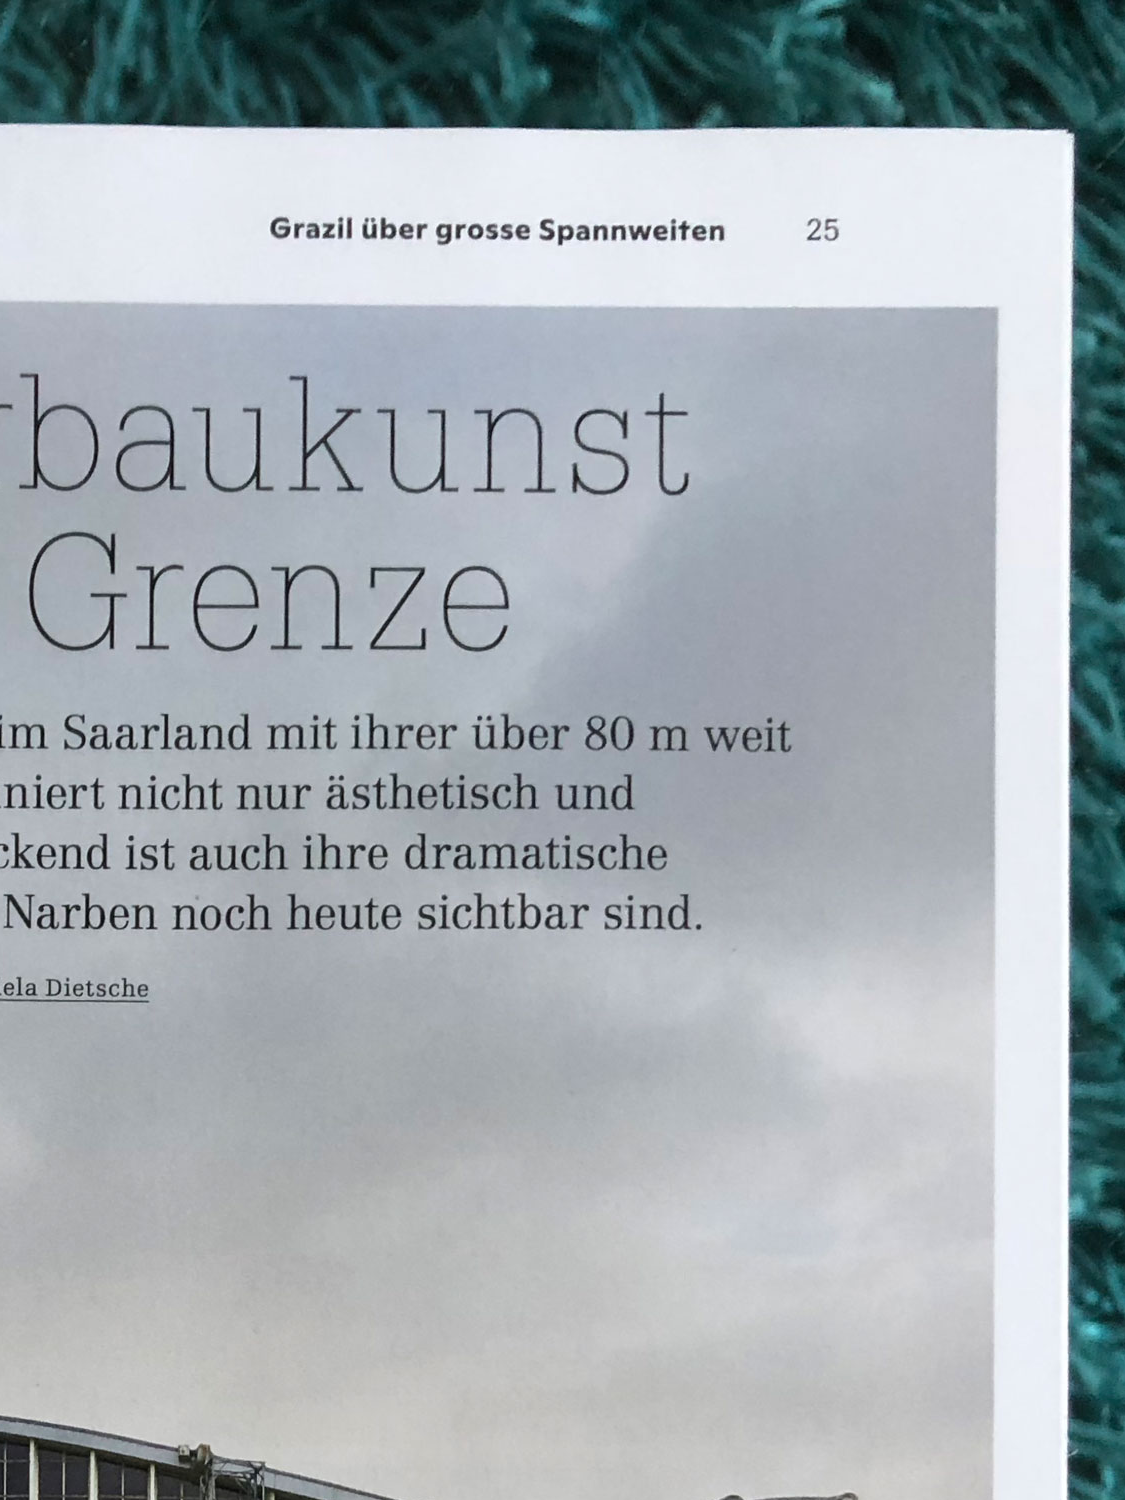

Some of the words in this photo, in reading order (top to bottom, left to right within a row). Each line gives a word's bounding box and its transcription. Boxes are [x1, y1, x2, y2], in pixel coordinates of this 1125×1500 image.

[269, 216, 353, 240] Grazil
[361, 216, 428, 240] über
[435, 223, 531, 246] grosse
[539, 218, 725, 246] Spannweiten
[806, 217, 840, 242] 25
[28, 531, 510, 653] Grenze
[63, 713, 252, 751] Saarland
[266, 714, 338, 750] mit
[351, 712, 458, 751] ihrer
[471, 713, 570, 751] über
[584, 715, 635, 751] 80
[649, 725, 689, 752] m
[703, 717, 792, 753] weit
[118, 773, 223, 811] nicht
[236, 784, 312, 811] nur
[326, 772, 540, 810] ästhetisch
[554, 773, 635, 811] und
[125, 834, 176, 871] ist
[189, 833, 289, 871] auch
[302, 833, 389, 871] ihre
[404, 832, 668, 871] dramatische
[3, 892, 158, 931] Narben
[171, 893, 273, 931] noch
[286, 893, 402, 931] heute
[417, 892, 590, 930] sichtbar
[604, 893, 702, 931] sind.
[45, 977, 149, 998] Dietsche
